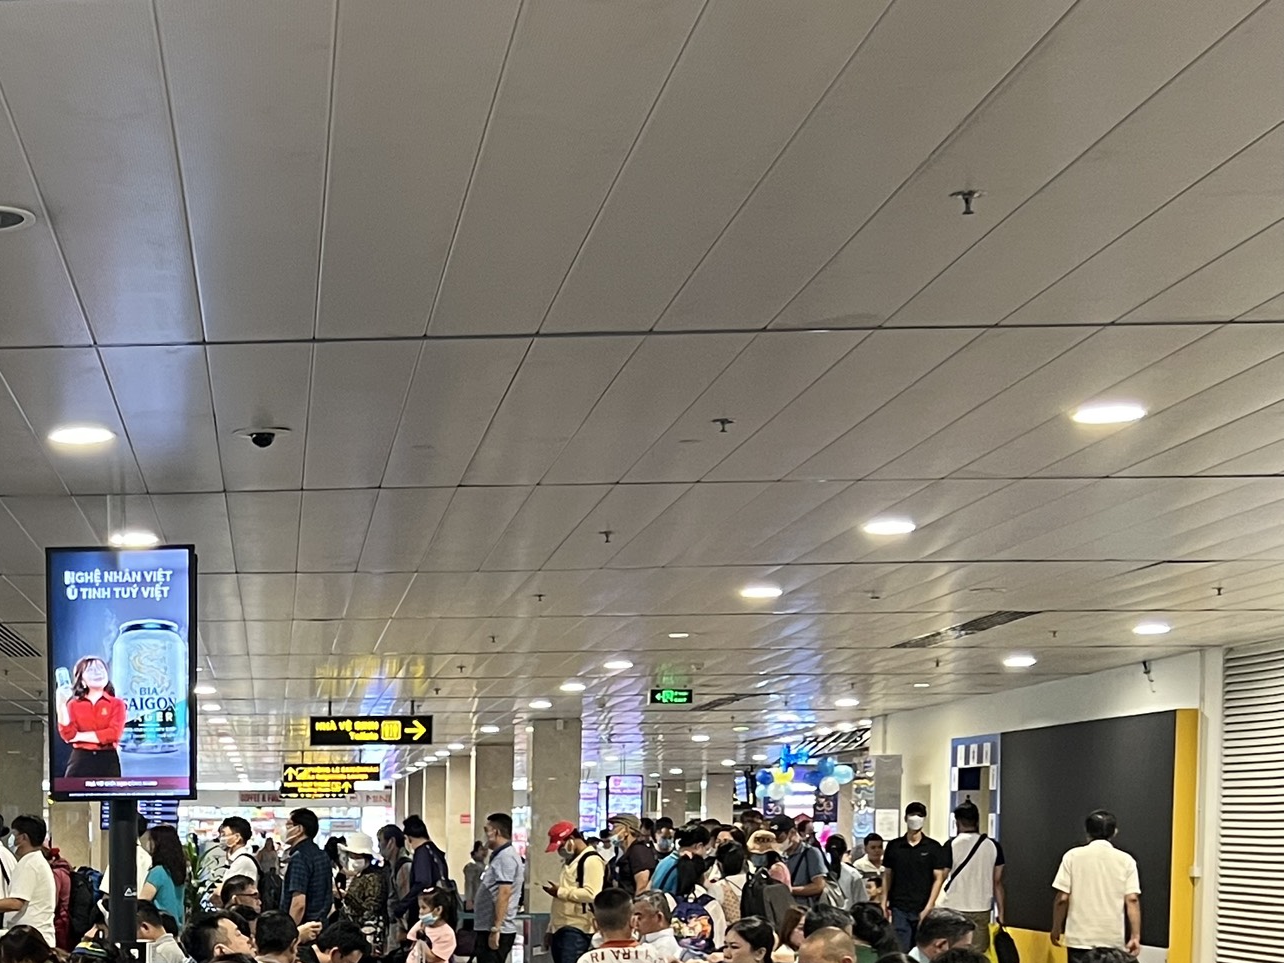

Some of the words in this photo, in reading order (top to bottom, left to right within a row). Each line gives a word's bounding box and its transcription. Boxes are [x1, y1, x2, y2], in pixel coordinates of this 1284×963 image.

[144, 567, 173, 585] VIỆT
[141, 583, 170, 601] VIỆT
[139, 687, 158, 695] BIA
